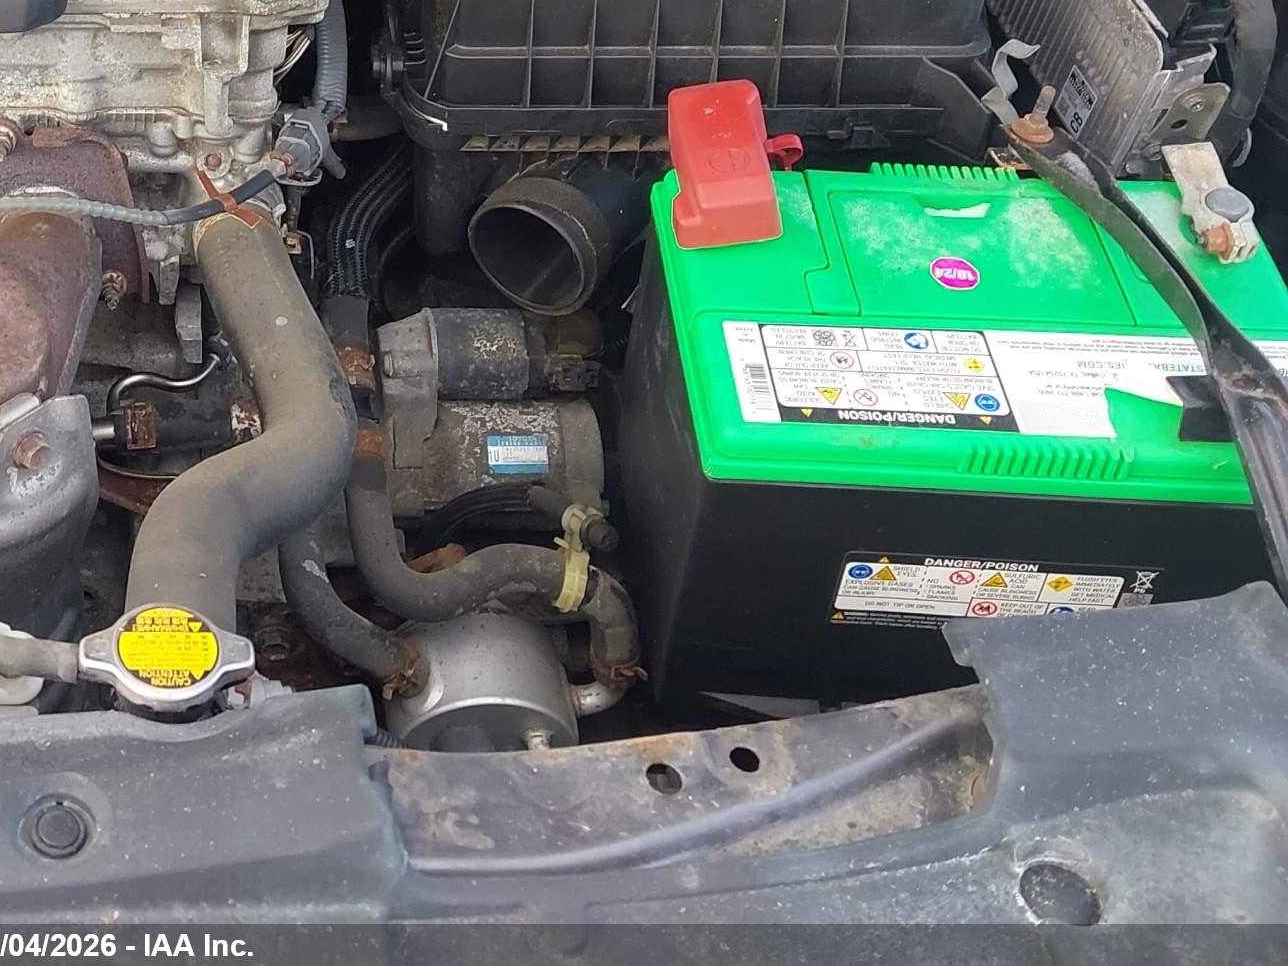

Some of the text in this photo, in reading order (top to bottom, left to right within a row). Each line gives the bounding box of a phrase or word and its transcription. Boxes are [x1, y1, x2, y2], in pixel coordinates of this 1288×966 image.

[838, 410, 957, 425] DANGER/POISON
[924, 557, 1040, 572] DANGER/POISON
[1004, 572, 1042, 580] SULFURIC
[139, 669, 190, 678] ATTENTION
[151, 677, 191, 686] CAUTION
